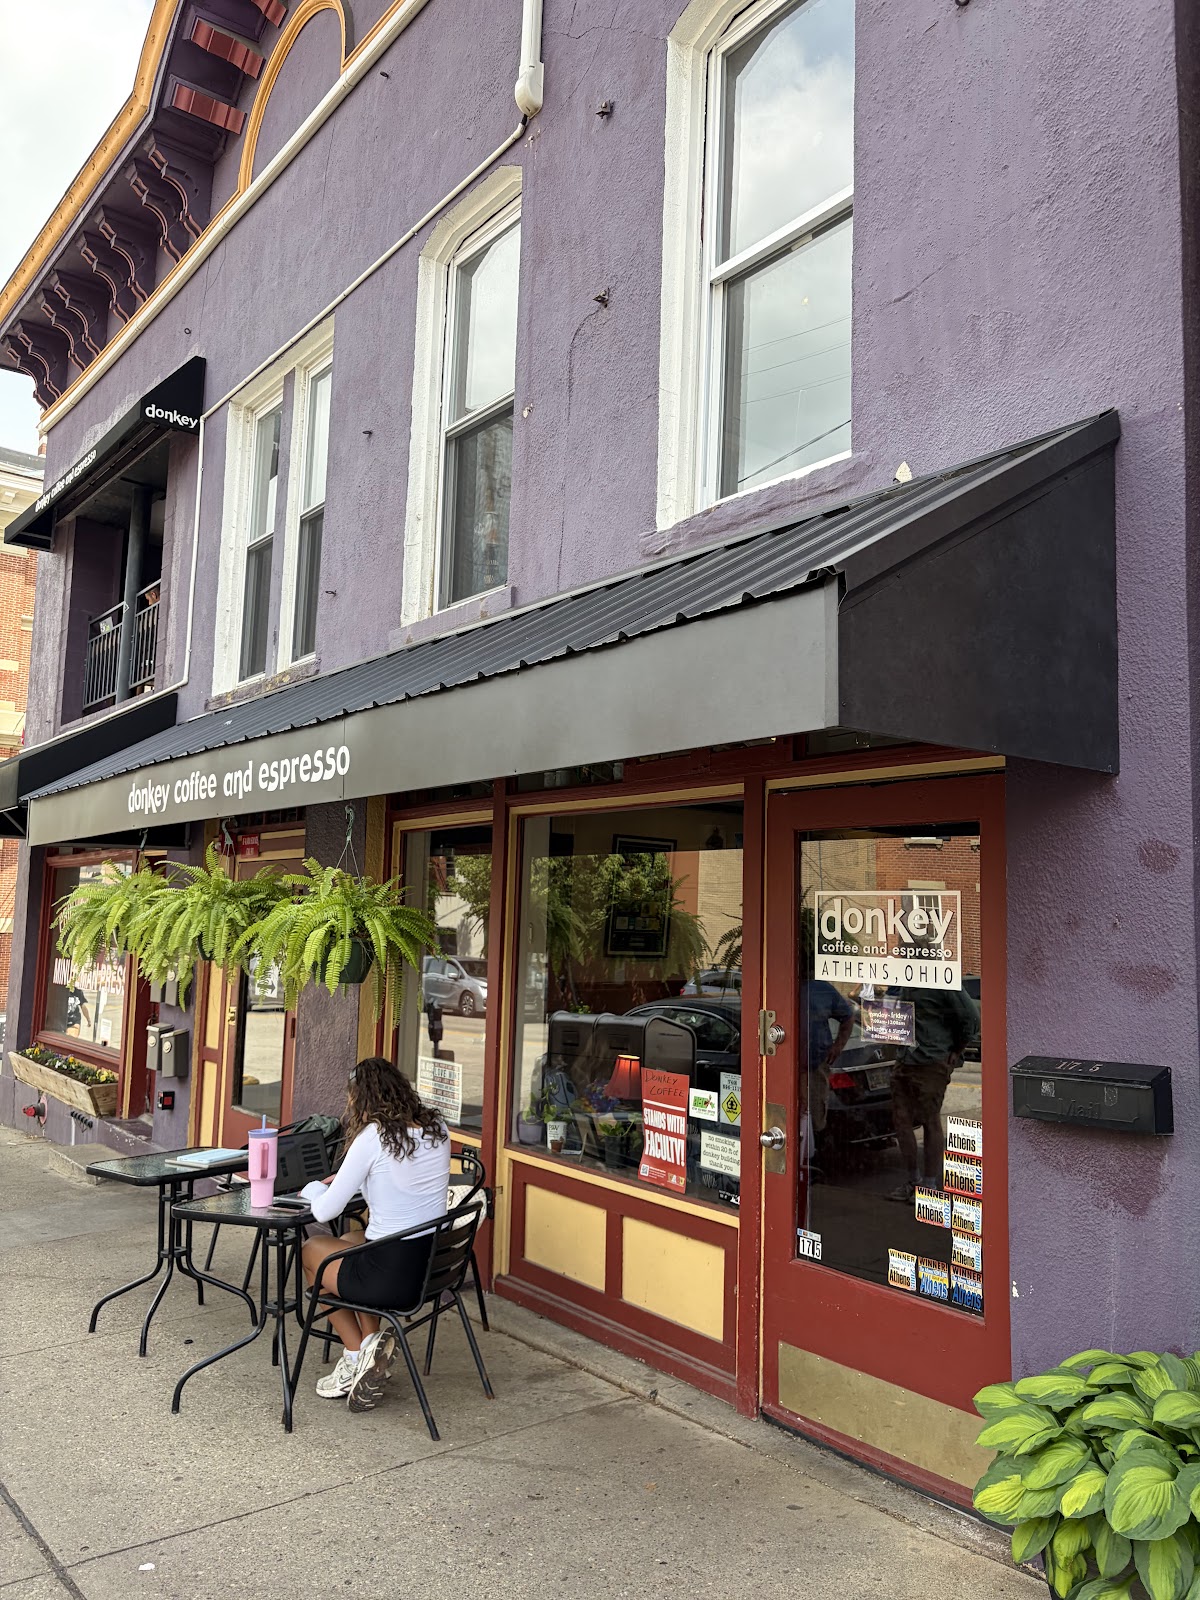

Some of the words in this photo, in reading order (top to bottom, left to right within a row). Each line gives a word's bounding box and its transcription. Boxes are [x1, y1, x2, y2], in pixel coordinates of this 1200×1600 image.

[145, 404, 198, 429] donkey
[128, 779, 170, 814] donkey
[174, 770, 217, 804] coffee
[223, 760, 253, 799] and
[258, 745, 350, 792] espresso
[820, 898, 954, 943] donkey
[822, 940, 858, 954] coffee
[864, 943, 887, 955] and
[892, 946, 952, 959] espresso
[53, 957, 98, 991] MINUMAN
[645, 1069, 678, 1085] DONKEY
[650, 1085, 685, 1097] COFFEE
[643, 1107, 666, 1130] STANDS
[667, 1113, 685, 1134] WITH
[948, 1116, 982, 1129] WINNER
[645, 1129, 685, 1167] FACULTY!
[705, 1142, 720, 1151] within
[715, 1137, 735, 1148] smoking
[948, 1133, 976, 1152] Athens
[703, 1150, 720, 1160] donkey
[720, 1154, 740, 1166] building
[709, 1160, 723, 1168] thank
[945, 1152, 982, 1167] WINNER
[944, 1169, 975, 1192] Athens
[917, 1187, 950, 1201] WINNER
[953, 1195, 981, 1208] WINNER
[917, 1203, 944, 1223] Athens
[953, 1214, 975, 1231] Athens
[953, 1230, 981, 1244] WINNER
[801, 1239, 821, 1258] 175
[890, 1250, 915, 1262] WINNER
[919, 1257, 948, 1272] WINNER!
[952, 1250, 975, 1268] Athens
[890, 1269, 910, 1287] Athens
[952, 1265, 982, 1283] WINNER
[920, 1272, 948, 1299] Athens
[953, 1282, 982, 1310] Athens
